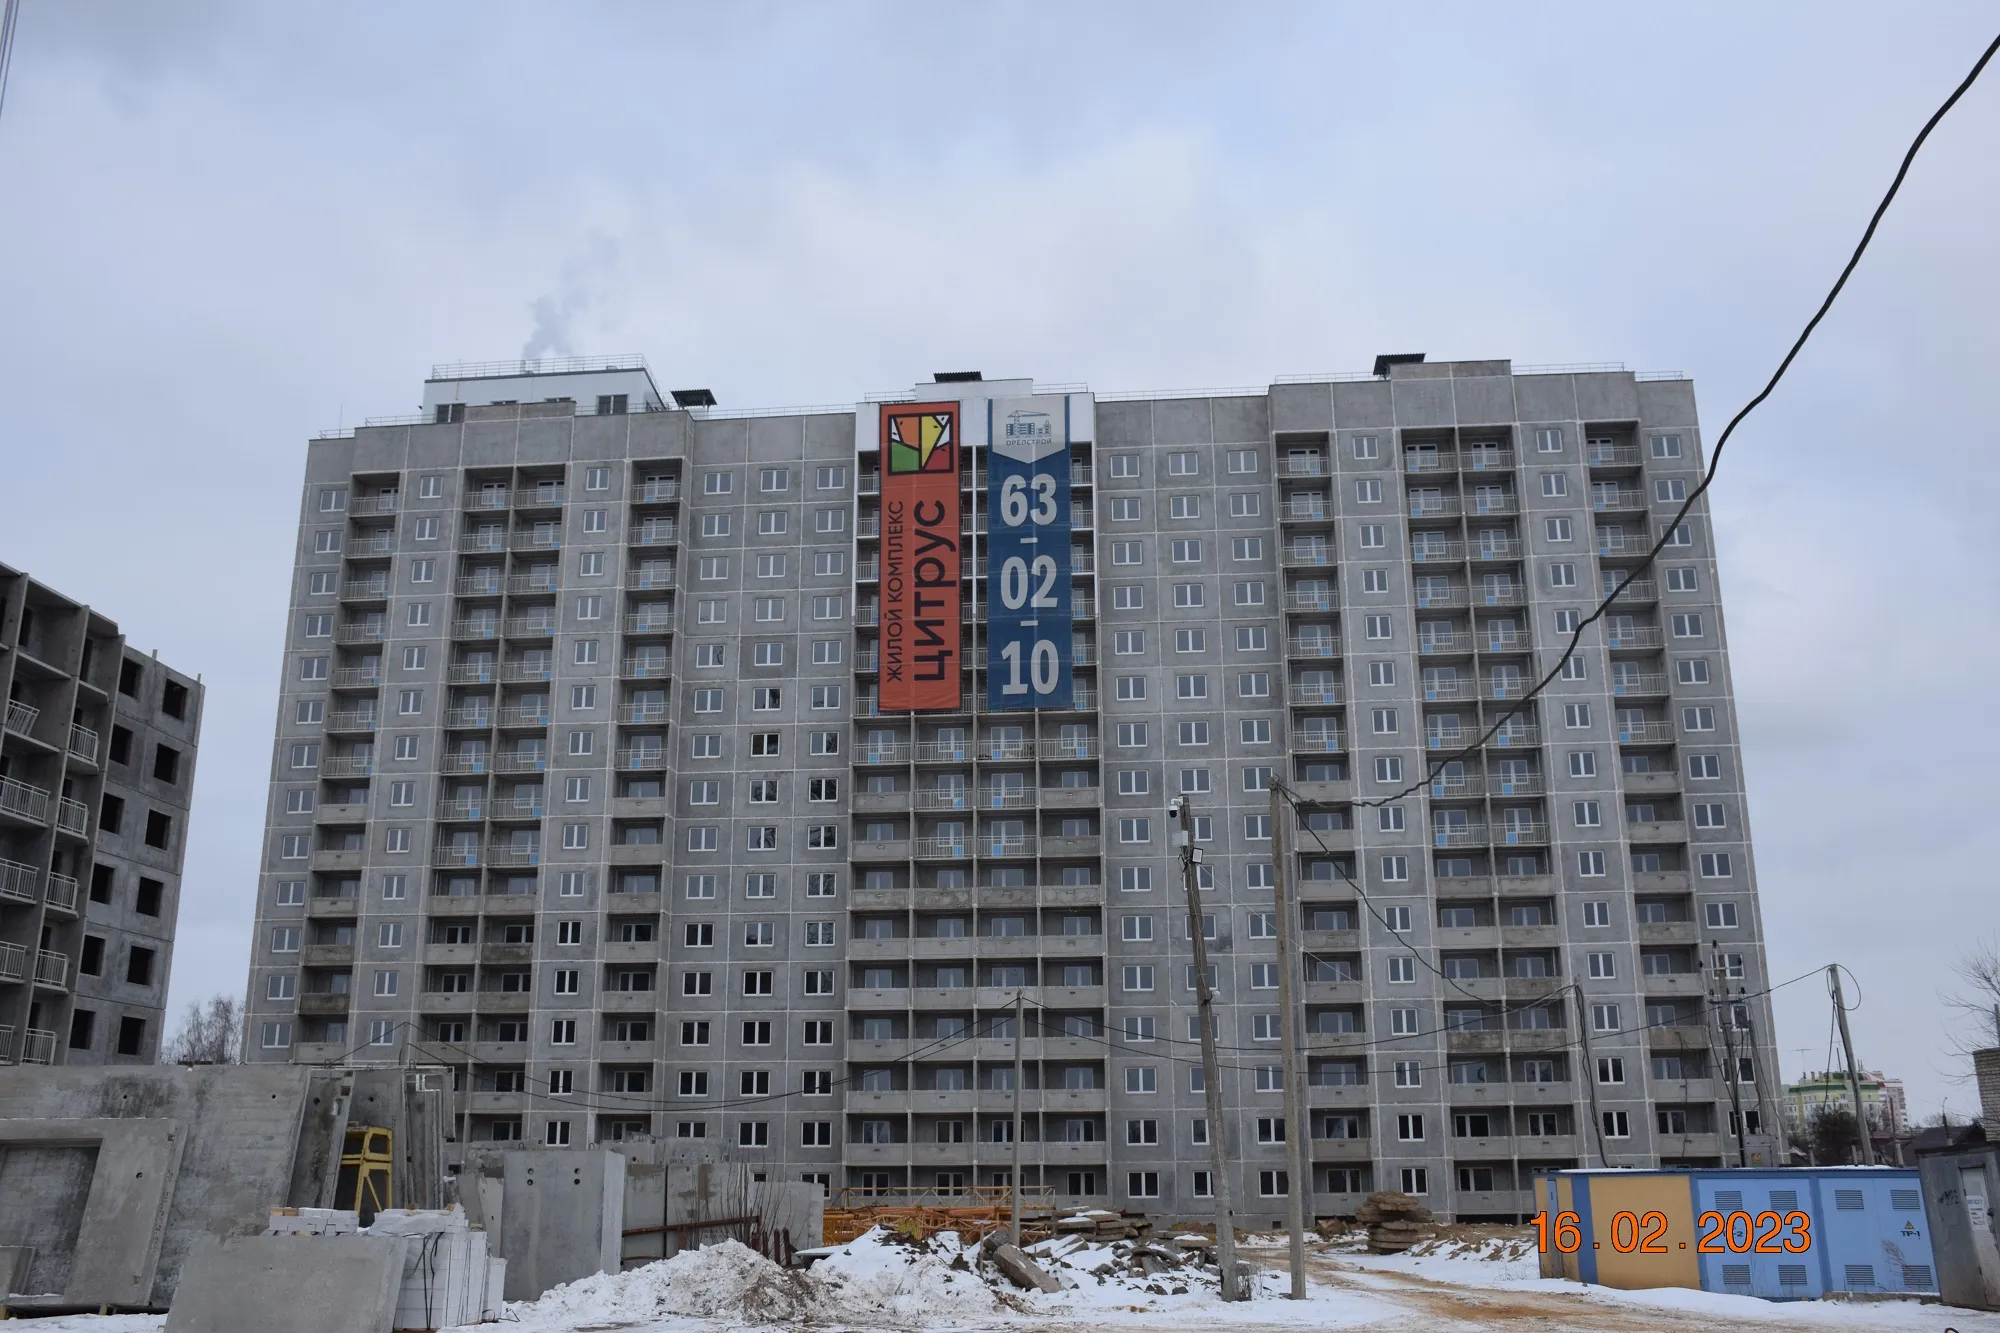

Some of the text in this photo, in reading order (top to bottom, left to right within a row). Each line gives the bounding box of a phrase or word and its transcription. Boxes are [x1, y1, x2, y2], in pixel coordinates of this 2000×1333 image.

[1000, 473, 1058, 527] 63
[884, 500, 904, 682] ЖИЛОЙ КОМПЛЕКС
[1000, 554, 1059, 610] 02
[1001, 639, 1060, 695] 10
